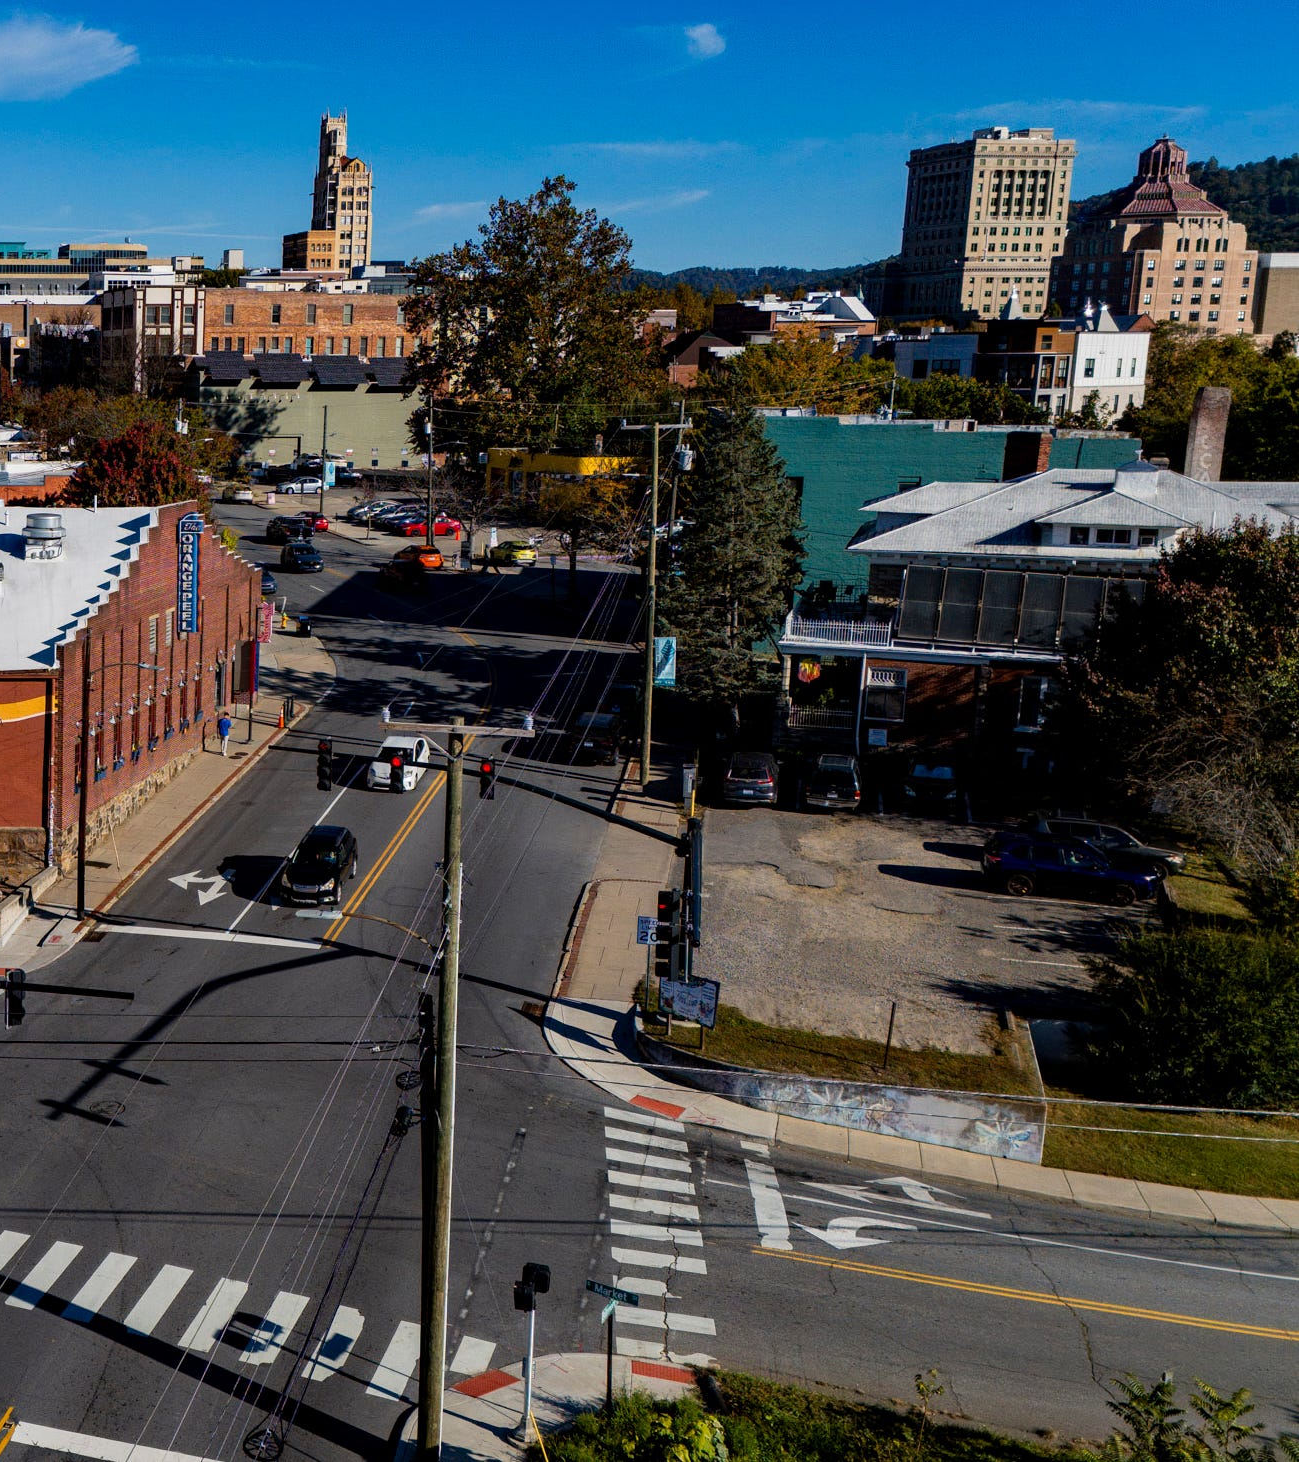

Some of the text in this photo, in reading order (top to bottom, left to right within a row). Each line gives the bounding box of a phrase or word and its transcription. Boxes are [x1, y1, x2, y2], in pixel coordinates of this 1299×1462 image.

[183, 522, 201, 532] The
[182, 534, 194, 630] ORANGE PEEL
[594, 1283, 628, 1302] Market
